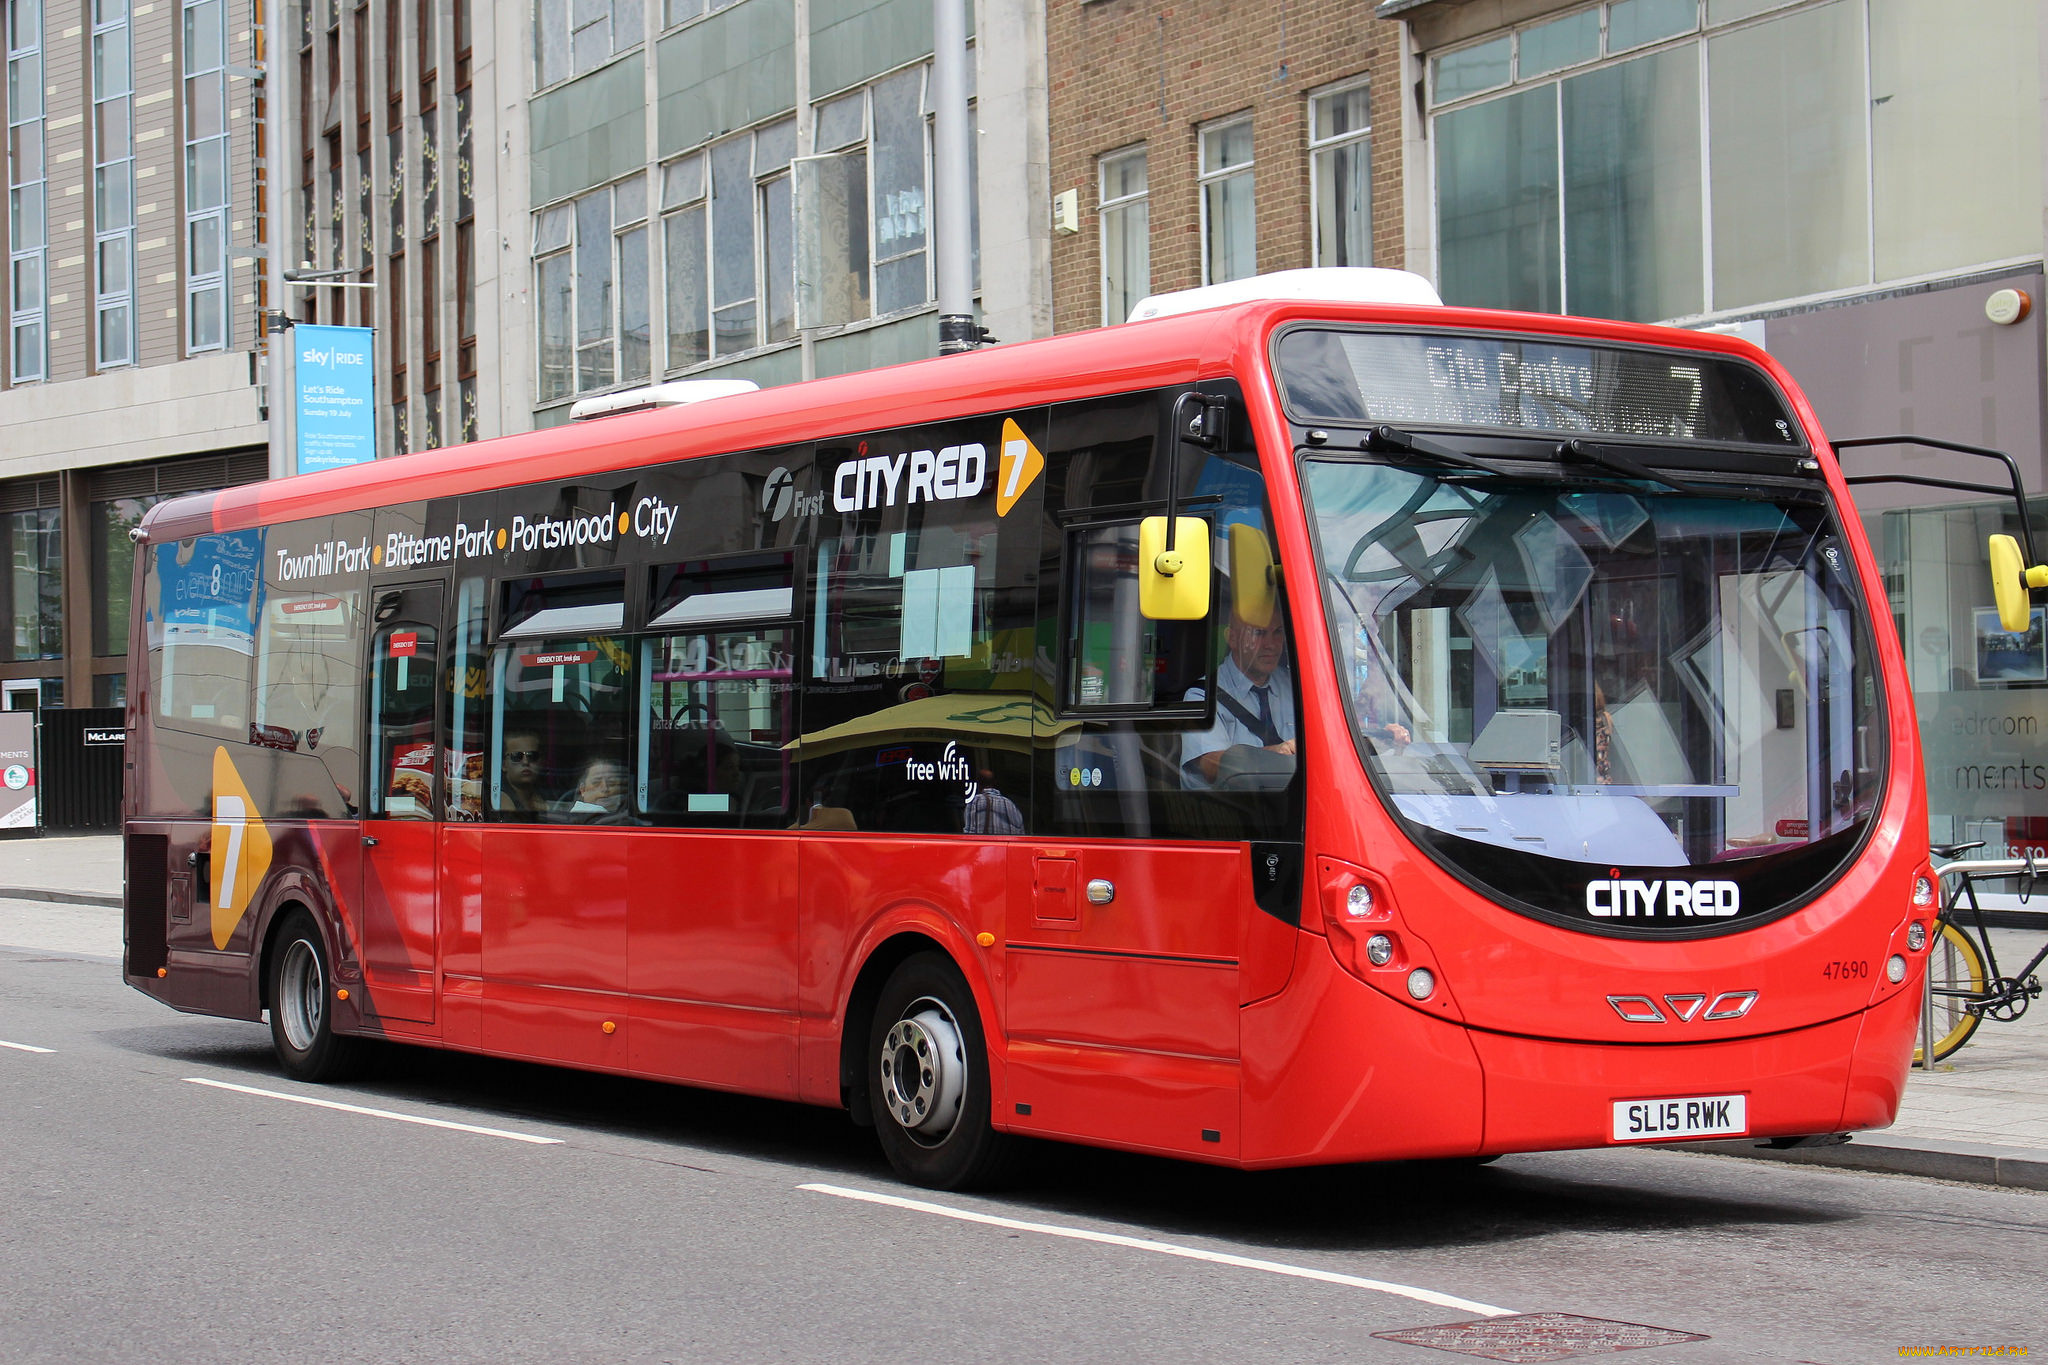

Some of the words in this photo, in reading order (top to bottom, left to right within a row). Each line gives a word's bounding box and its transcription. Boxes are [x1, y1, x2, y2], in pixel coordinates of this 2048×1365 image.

[303, 348, 329, 366] sky
[336, 352, 364, 365] RIDE
[1427, 345, 1487, 391] City
[1498, 352, 1595, 399] Centre
[303, 385, 325, 394] Let's
[325, 385, 345, 395] Ride
[303, 395, 364, 406] Southampton
[1669, 366, 1702, 437] 7
[303, 409, 329, 418] Sunday
[338, 410, 352, 418] July
[832, 441, 907, 512] CITY
[907, 442, 987, 504] RED
[1003, 439, 1028, 497] 7
[793, 489, 824, 518] First
[276, 540, 334, 582] Townhill
[335, 535, 371, 574] Park
[384, 530, 451, 568] Bitterne
[453, 518, 494, 559] Park
[510, 502, 615, 553] Portswood
[633, 496, 679, 545] City
[176, 576, 210, 606] every
[211, 563, 221, 596] 8
[223, 569, 255, 593] mins
[87, 732, 126, 741] McLARE
[1952, 711, 2038, 736] edroom
[0, 751, 29, 759] MENTS
[906, 757, 934, 781] free
[1955, 758, 2047, 790] ments
[216, 795, 246, 909] 7
[1586, 867, 1663, 917] CITY
[1665, 879, 1740, 917] RED
[1822, 960, 1869, 981] 47690
[1628, 1105, 1680, 1134] SL15
[1686, 1100, 1731, 1129] RWK
